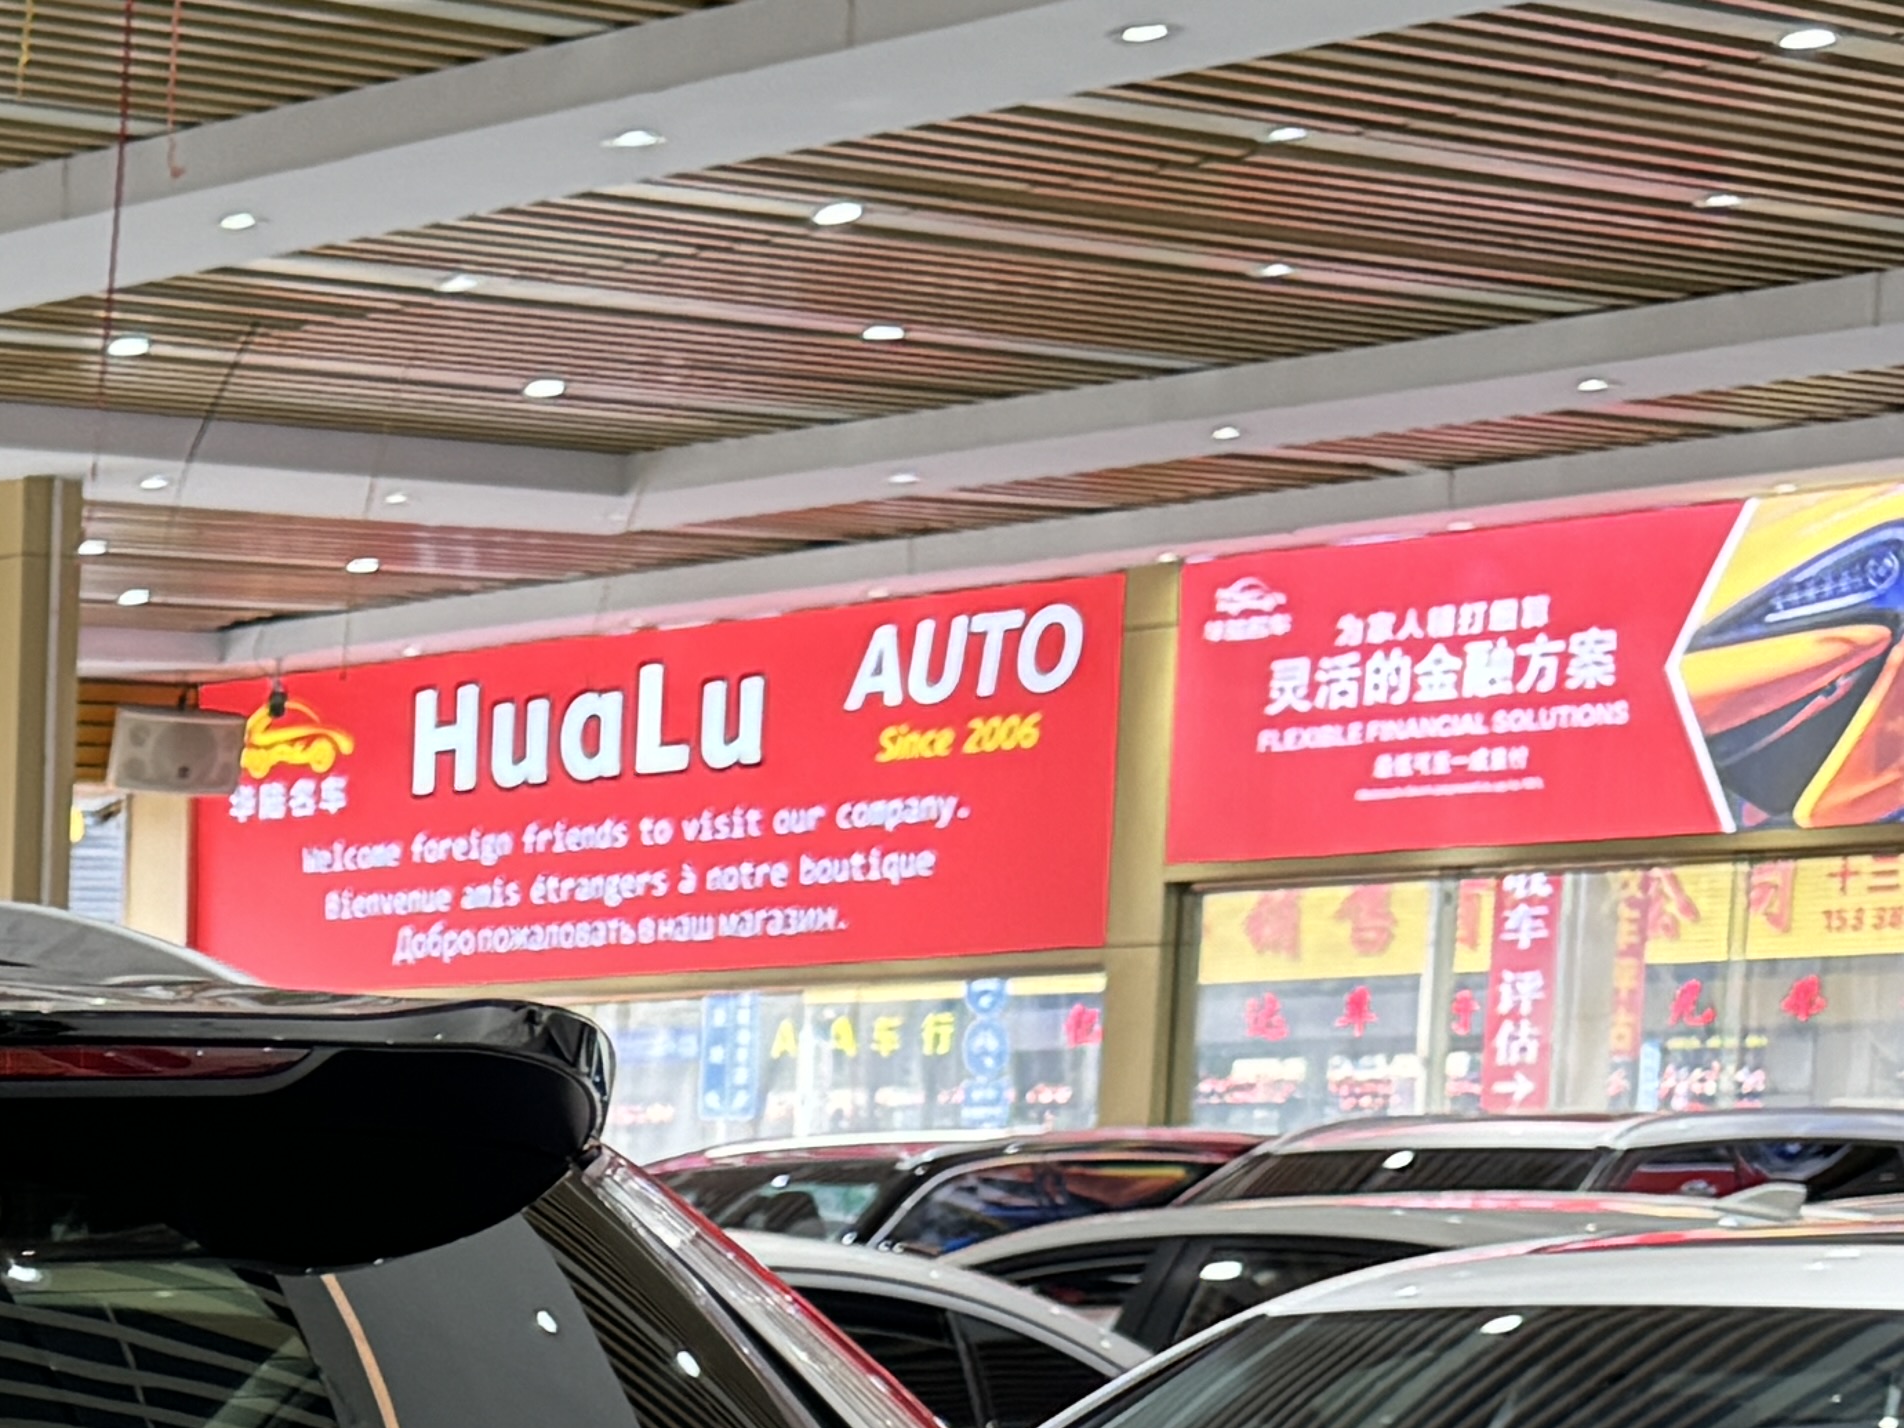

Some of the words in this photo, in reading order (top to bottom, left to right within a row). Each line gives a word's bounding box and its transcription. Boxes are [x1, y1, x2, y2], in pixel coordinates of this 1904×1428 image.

[844, 603, 1085, 714] AUTO
[1263, 626, 1618, 716] 灵活的金融方案
[410, 663, 766, 798] HuaLu
[876, 722, 958, 765] Since
[961, 711, 1041, 754] 2006
[1365, 712, 1491, 742] FINANCIAL
[1492, 700, 1630, 735] SOLUTIONS
[302, 840, 402, 874] Welcome
[412, 829, 515, 866] foreign
[523, 817, 629, 854] friends
[639, 814, 674, 846] to
[682, 806, 764, 842] visit
[772, 804, 826, 835] our
[835, 793, 972, 831] company.
[325, 885, 452, 920] Bienvenue
[461, 876, 522, 909] amis
[531, 869, 669, 908] étrangers
[677, 863, 698, 895] à
[706, 859, 789, 891] notre
[799, 846, 938, 885] boutique
